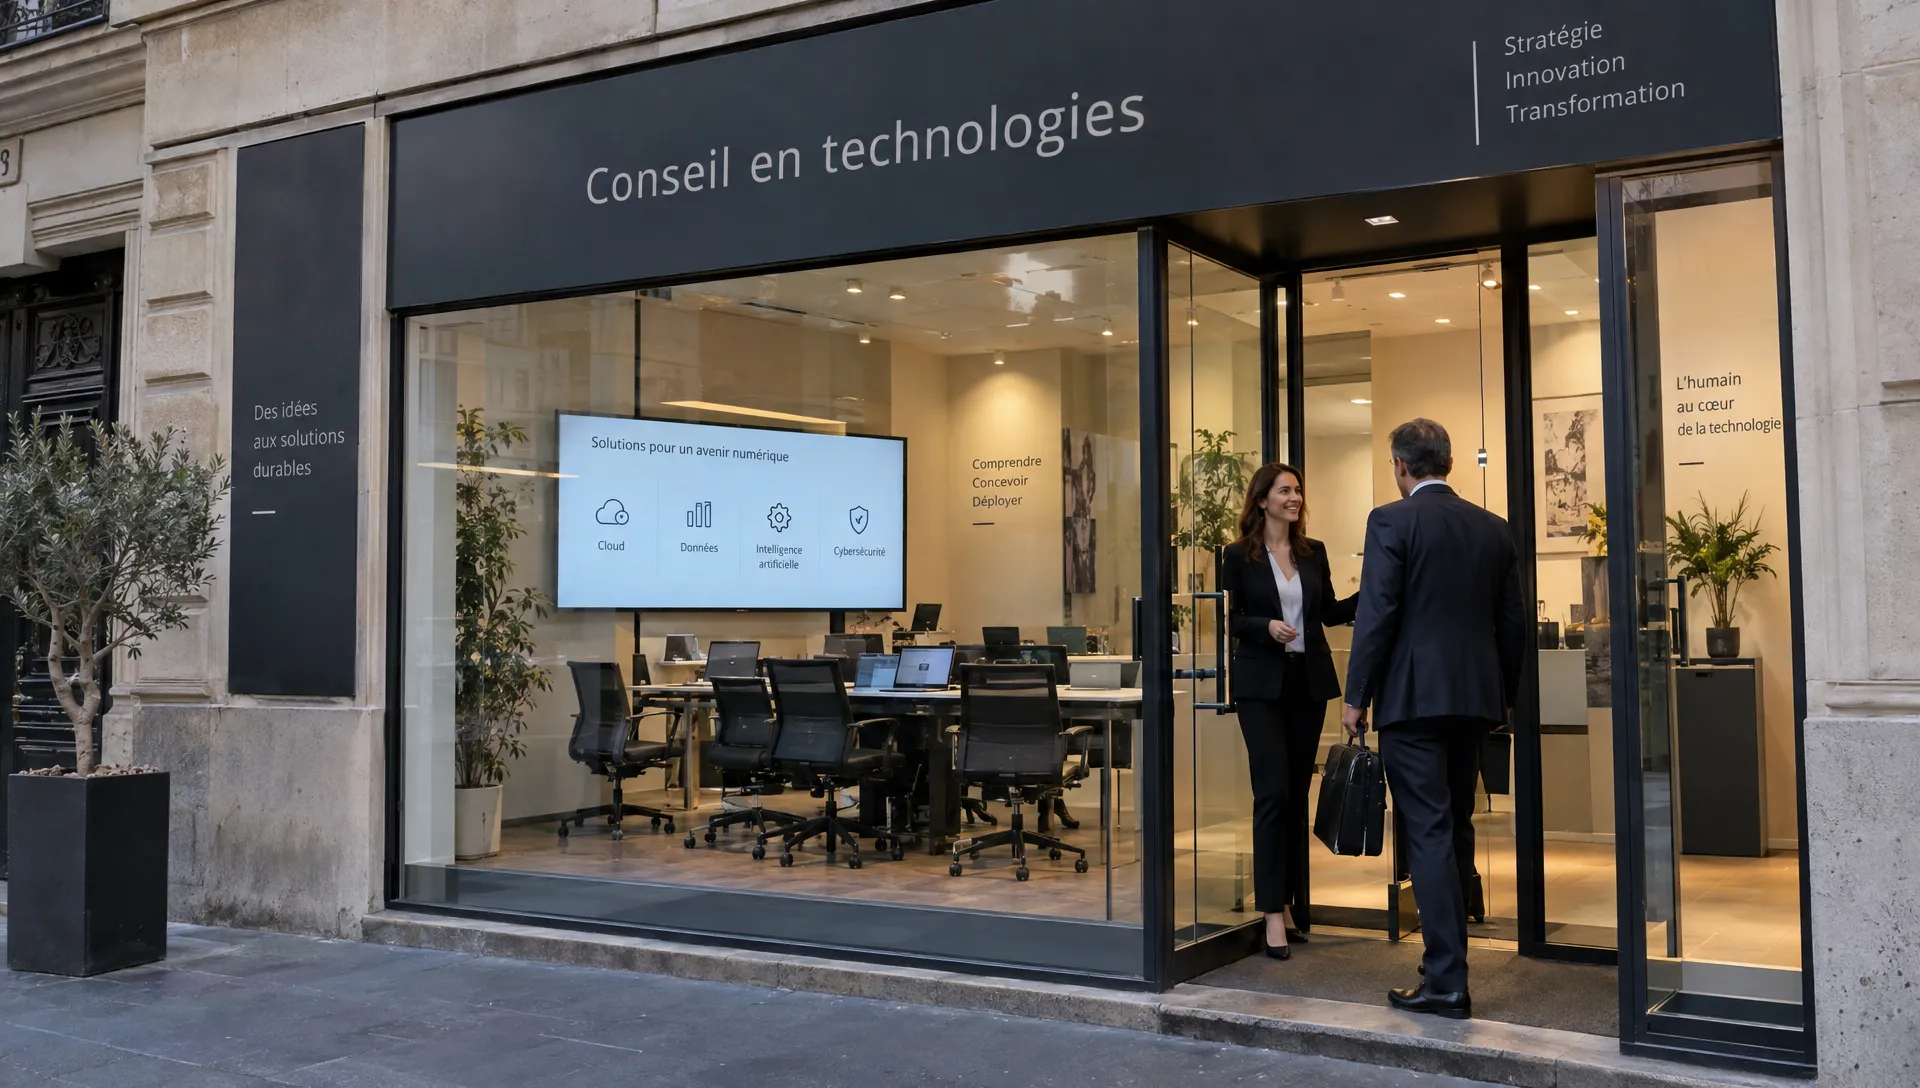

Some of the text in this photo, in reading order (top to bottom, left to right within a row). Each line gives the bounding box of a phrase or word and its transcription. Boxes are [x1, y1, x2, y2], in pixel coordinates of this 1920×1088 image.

[1504, 20, 1603, 56] Stratégie
[1506, 55, 1625, 90] Innovation
[1505, 81, 1685, 124] Transformation
[586, 91, 1145, 205] Conseil en technologies
[1676, 371, 1742, 391] L’humain
[254, 399, 318, 421] Des idées
[1676, 398, 1735, 414] au cœur
[1677, 416, 1782, 437] de la technologie
[253, 428, 345, 450] aux solutions
[591, 435, 789, 465] Solutions pour un avenir numérique
[253, 459, 312, 479] durables
[972, 455, 1042, 472] Comprendre
[972, 475, 1029, 489] Concevoir
[972, 494, 1023, 510] Déployer
[597, 540, 625, 551] Cloud
[680, 542, 719, 553] Données
[756, 543, 803, 557] Intelligence
[833, 546, 886, 558] Cybersécurité
[758, 559, 800, 570] artificielle
